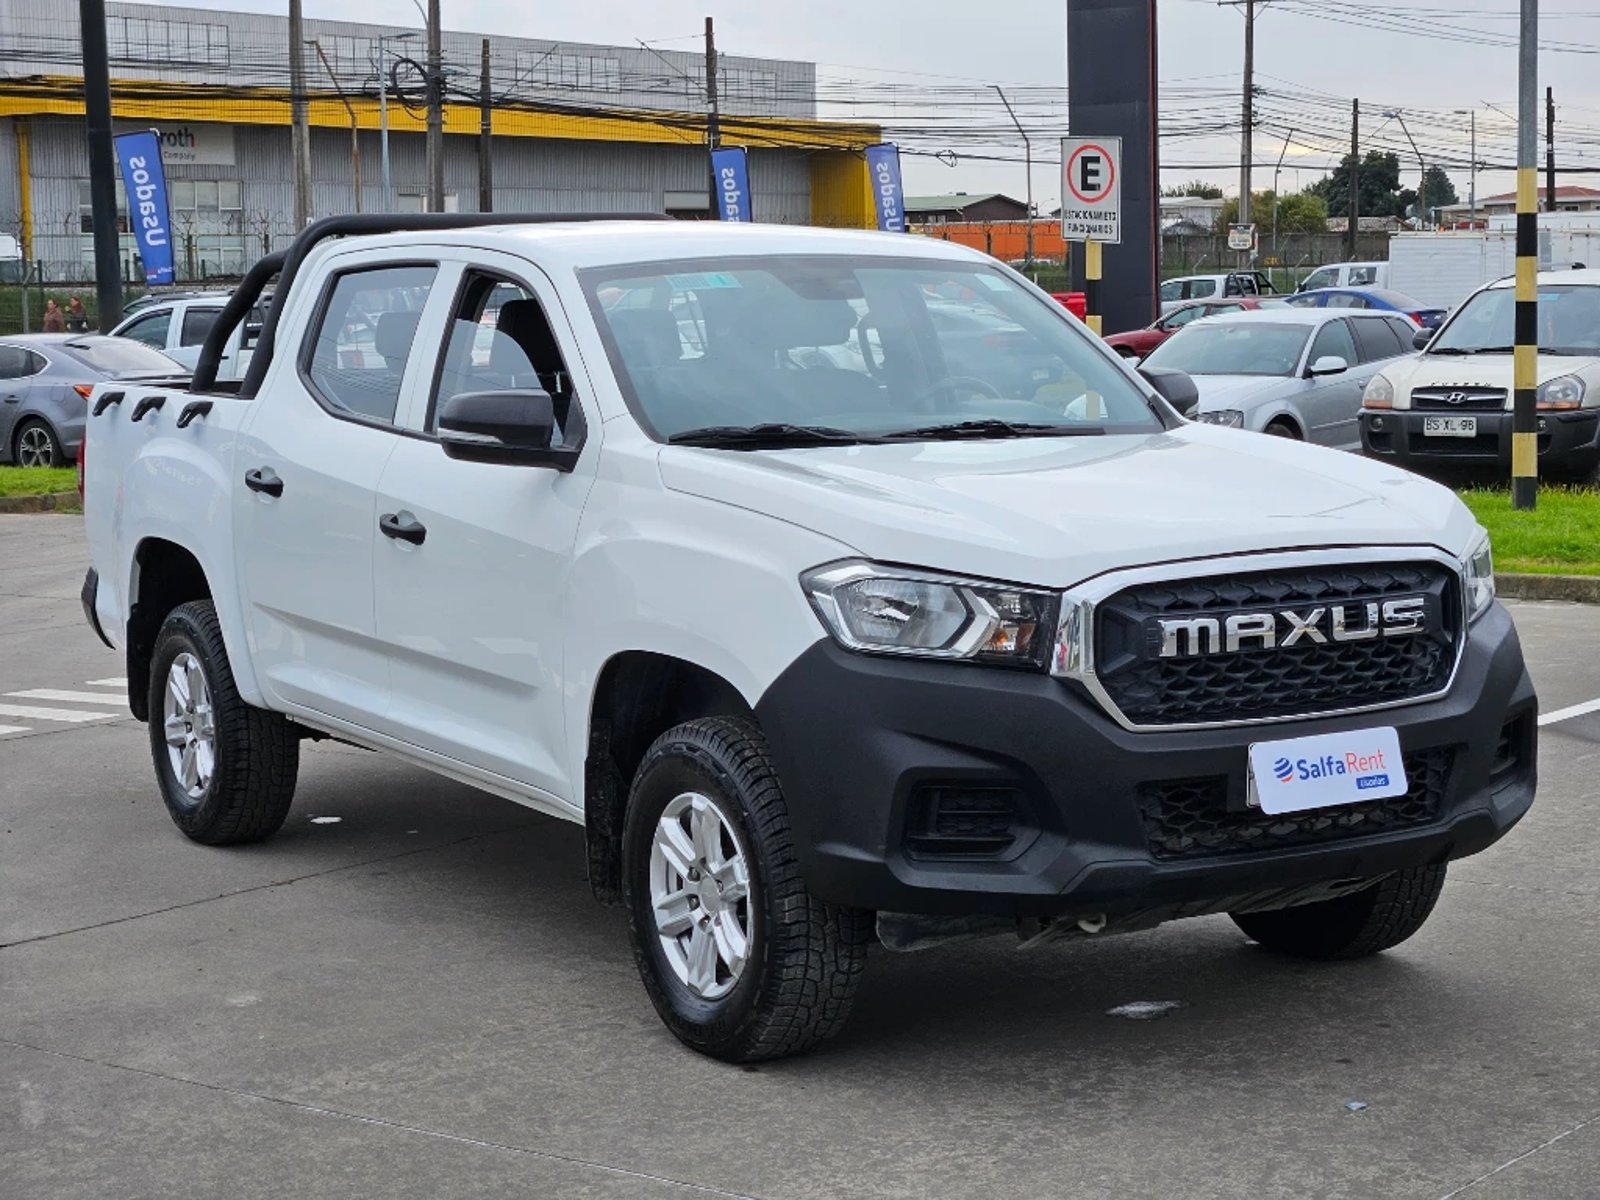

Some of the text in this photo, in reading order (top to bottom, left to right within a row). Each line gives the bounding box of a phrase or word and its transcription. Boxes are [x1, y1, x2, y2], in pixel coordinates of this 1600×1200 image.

[1081, 156, 1100, 191] E
[1158, 597, 1425, 657] MAXUS
[1296, 748, 1387, 780] SalfaRent
